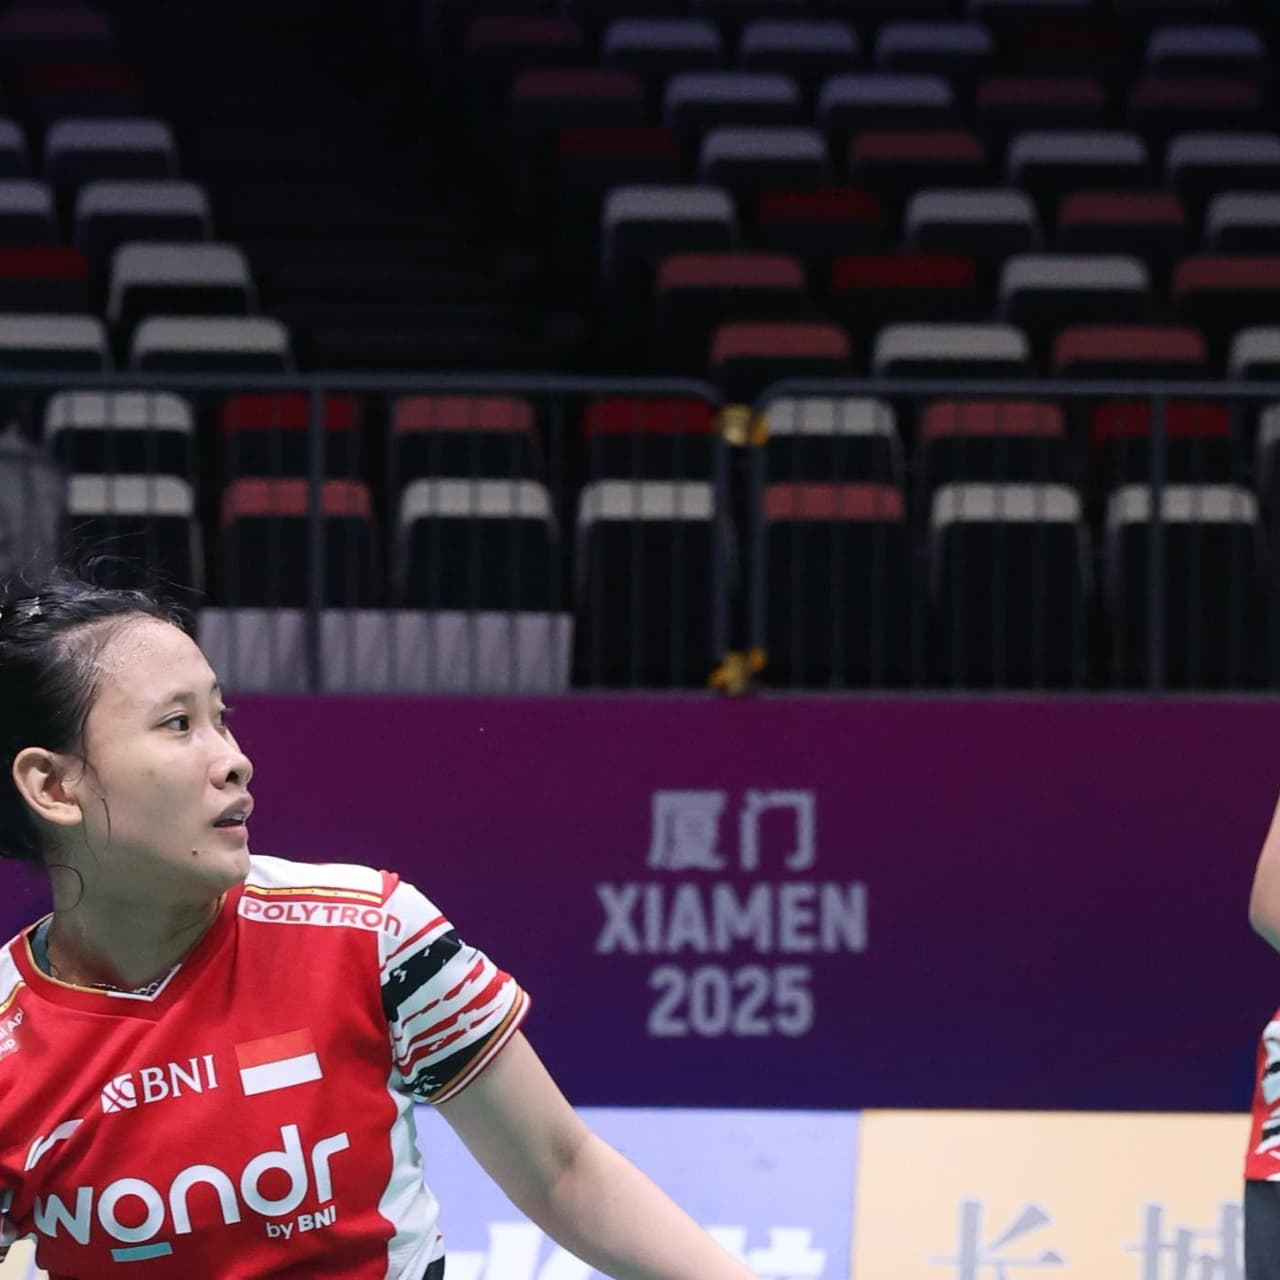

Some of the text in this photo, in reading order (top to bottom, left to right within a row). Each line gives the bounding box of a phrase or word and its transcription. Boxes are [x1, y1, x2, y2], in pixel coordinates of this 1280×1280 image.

[647, 790, 816, 870] 厦门
[243, 900, 403, 937] POLYTRON
[595, 882, 868, 954] XIAMEN
[647, 964, 814, 1037] 2025
[139, 1053, 219, 1104] BNI
[33, 1123, 350, 1246] wondr
[265, 1204, 337, 1240] by BNI
